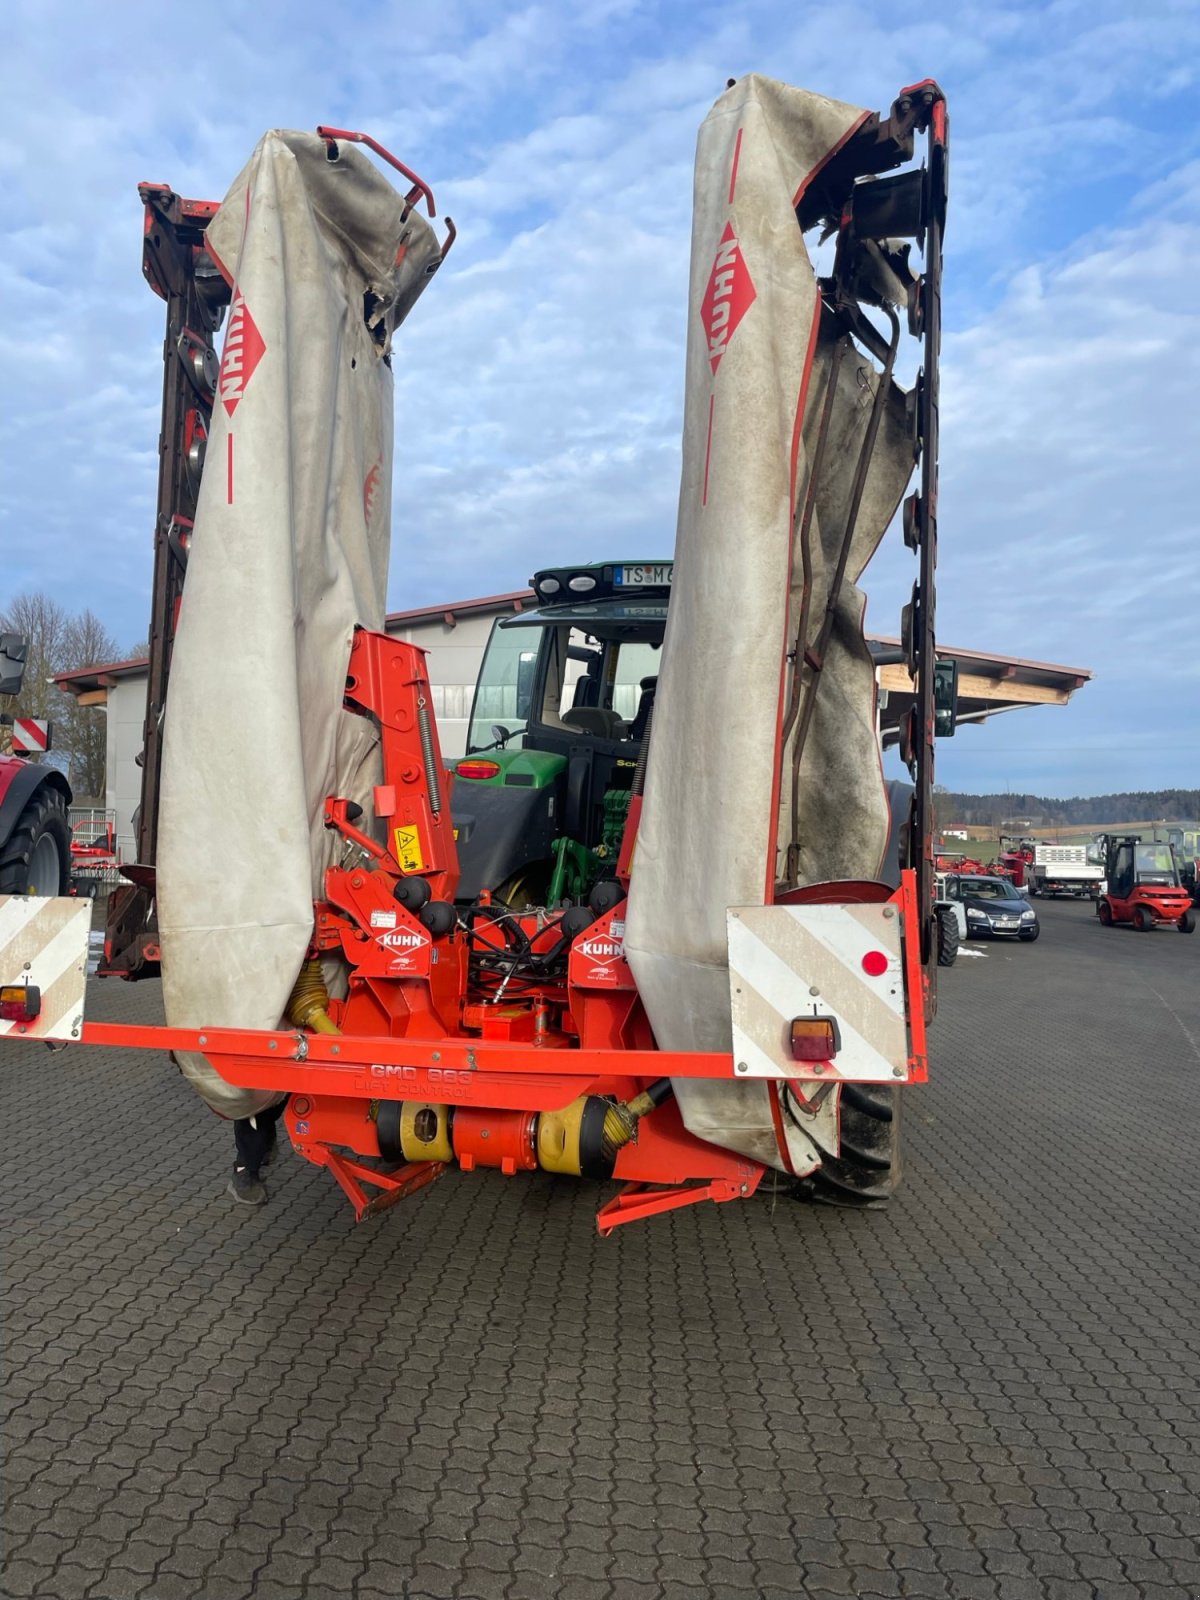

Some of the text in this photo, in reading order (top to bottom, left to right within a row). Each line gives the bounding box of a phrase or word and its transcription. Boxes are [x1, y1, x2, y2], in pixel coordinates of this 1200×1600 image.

[709, 239, 738, 361] KUHN
[221, 297, 244, 401] KUHN
[624, 567, 643, 583] TS
[653, 567, 664, 583] M
[383, 934, 421, 947] KUHN
[583, 943, 625, 955] KUHN
[370, 1064, 417, 1081] GMD
[397, 1082, 474, 1098] CONTROL
